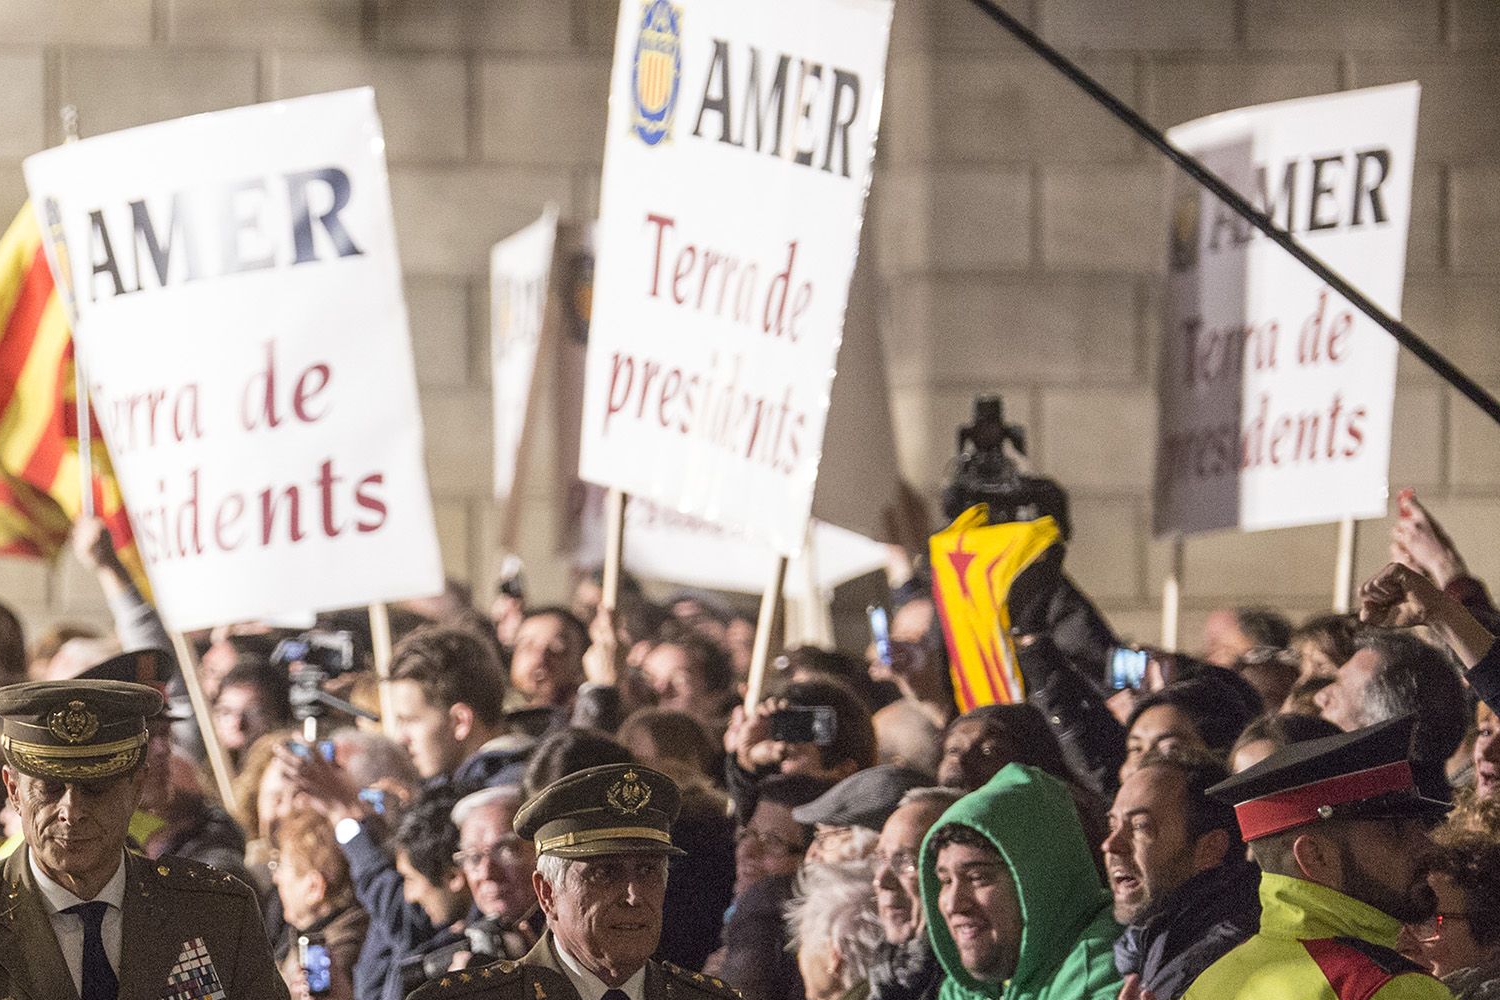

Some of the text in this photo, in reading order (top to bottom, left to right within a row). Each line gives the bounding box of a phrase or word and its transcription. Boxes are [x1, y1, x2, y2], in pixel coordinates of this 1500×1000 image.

[692, 38, 861, 179] AMER
[87, 167, 364, 303] AMER
[1207, 147, 1391, 253] AMER
[646, 212, 760, 325] Terra
[762, 239, 814, 343] de
[1299, 288, 1354, 366] de
[96, 338, 332, 456] erra de
[602, 349, 806, 476] presidents
